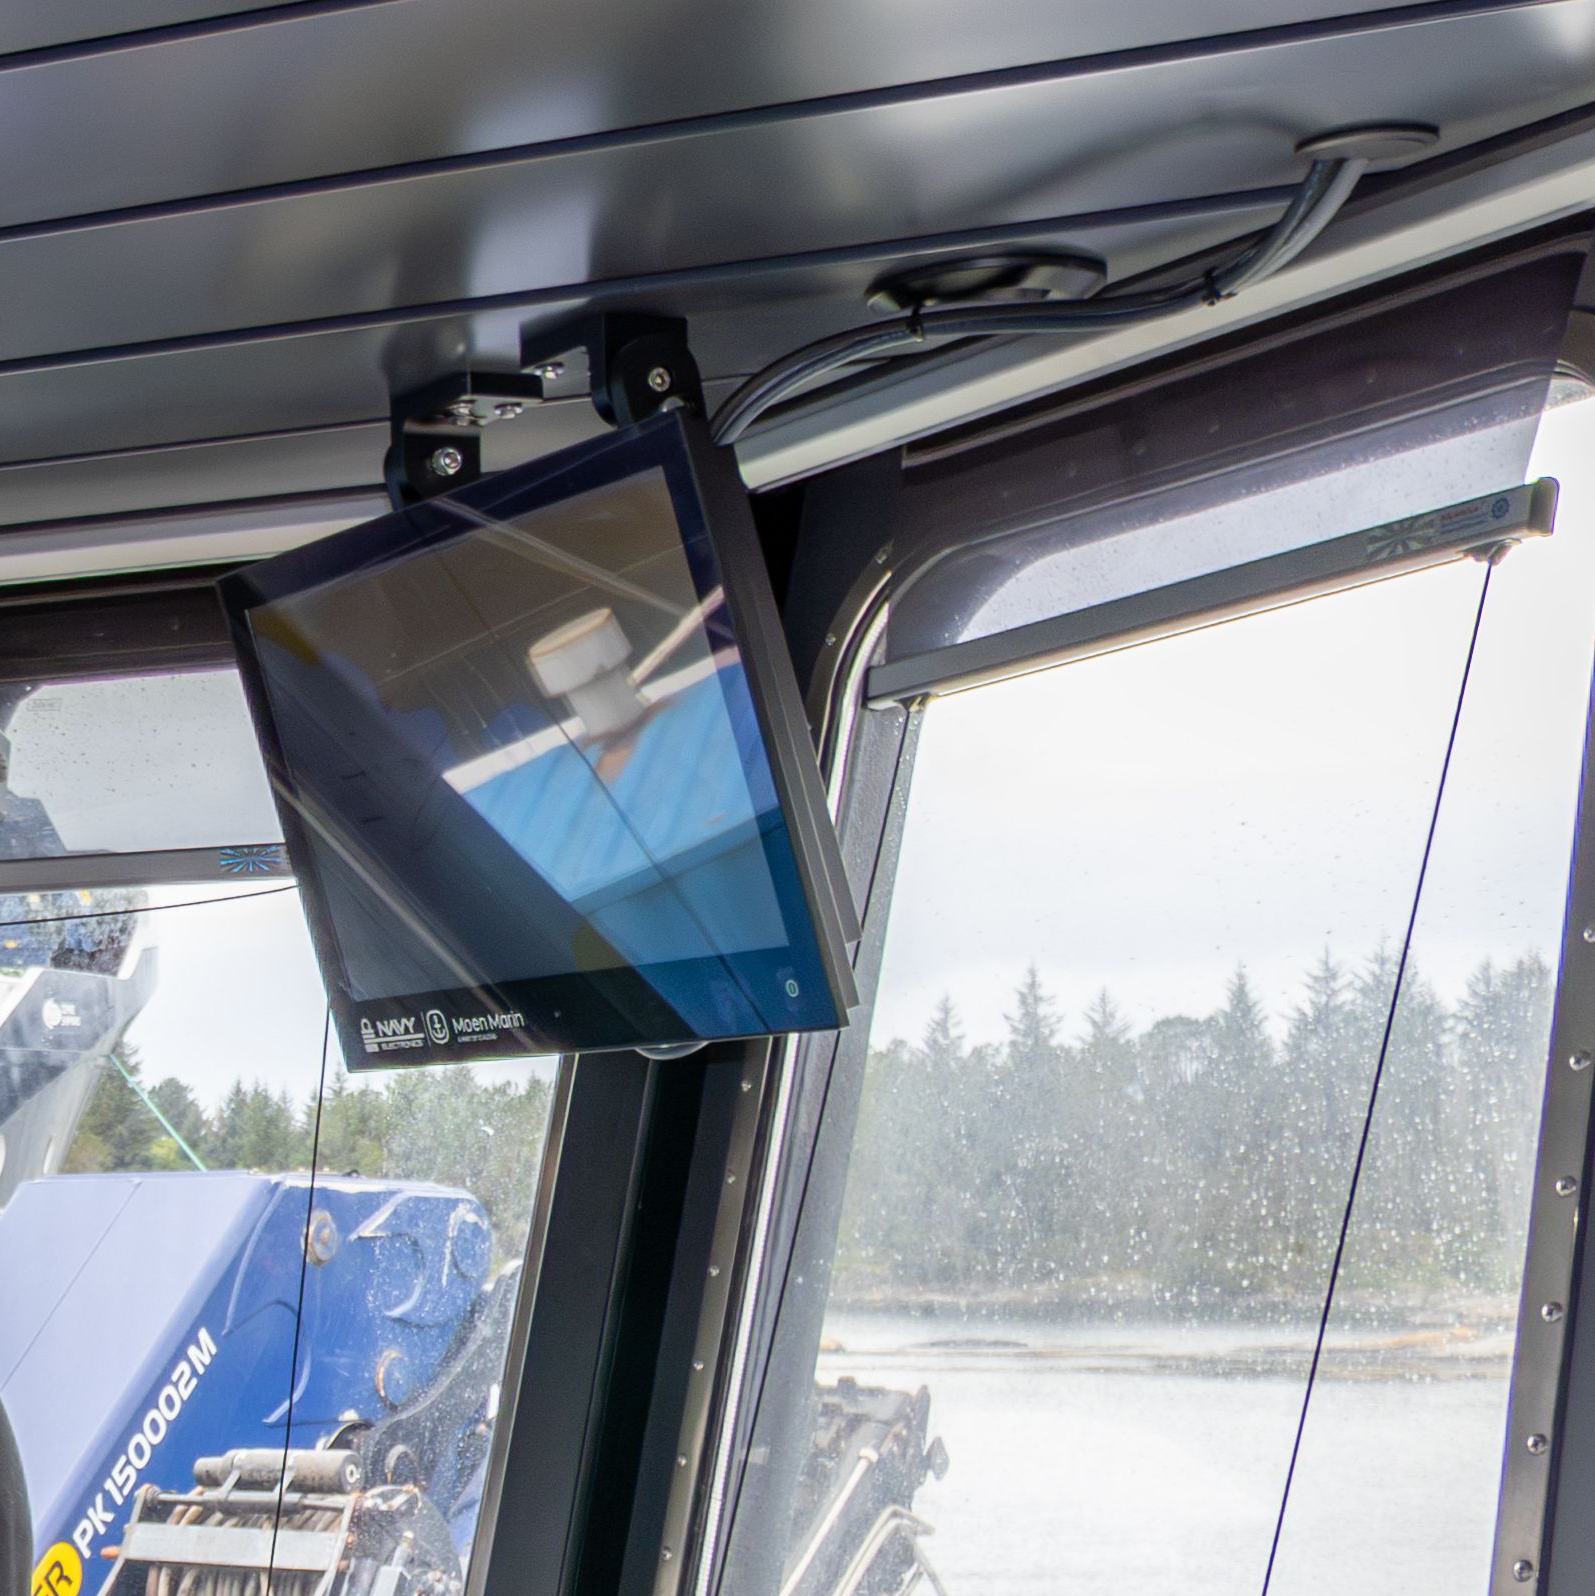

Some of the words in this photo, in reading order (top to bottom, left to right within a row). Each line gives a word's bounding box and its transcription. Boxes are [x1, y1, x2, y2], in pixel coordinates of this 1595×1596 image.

[375, 1016, 415, 1037] NAVY
[452, 1016, 489, 1035] Moen
[488, 1010, 525, 1031] Marin
